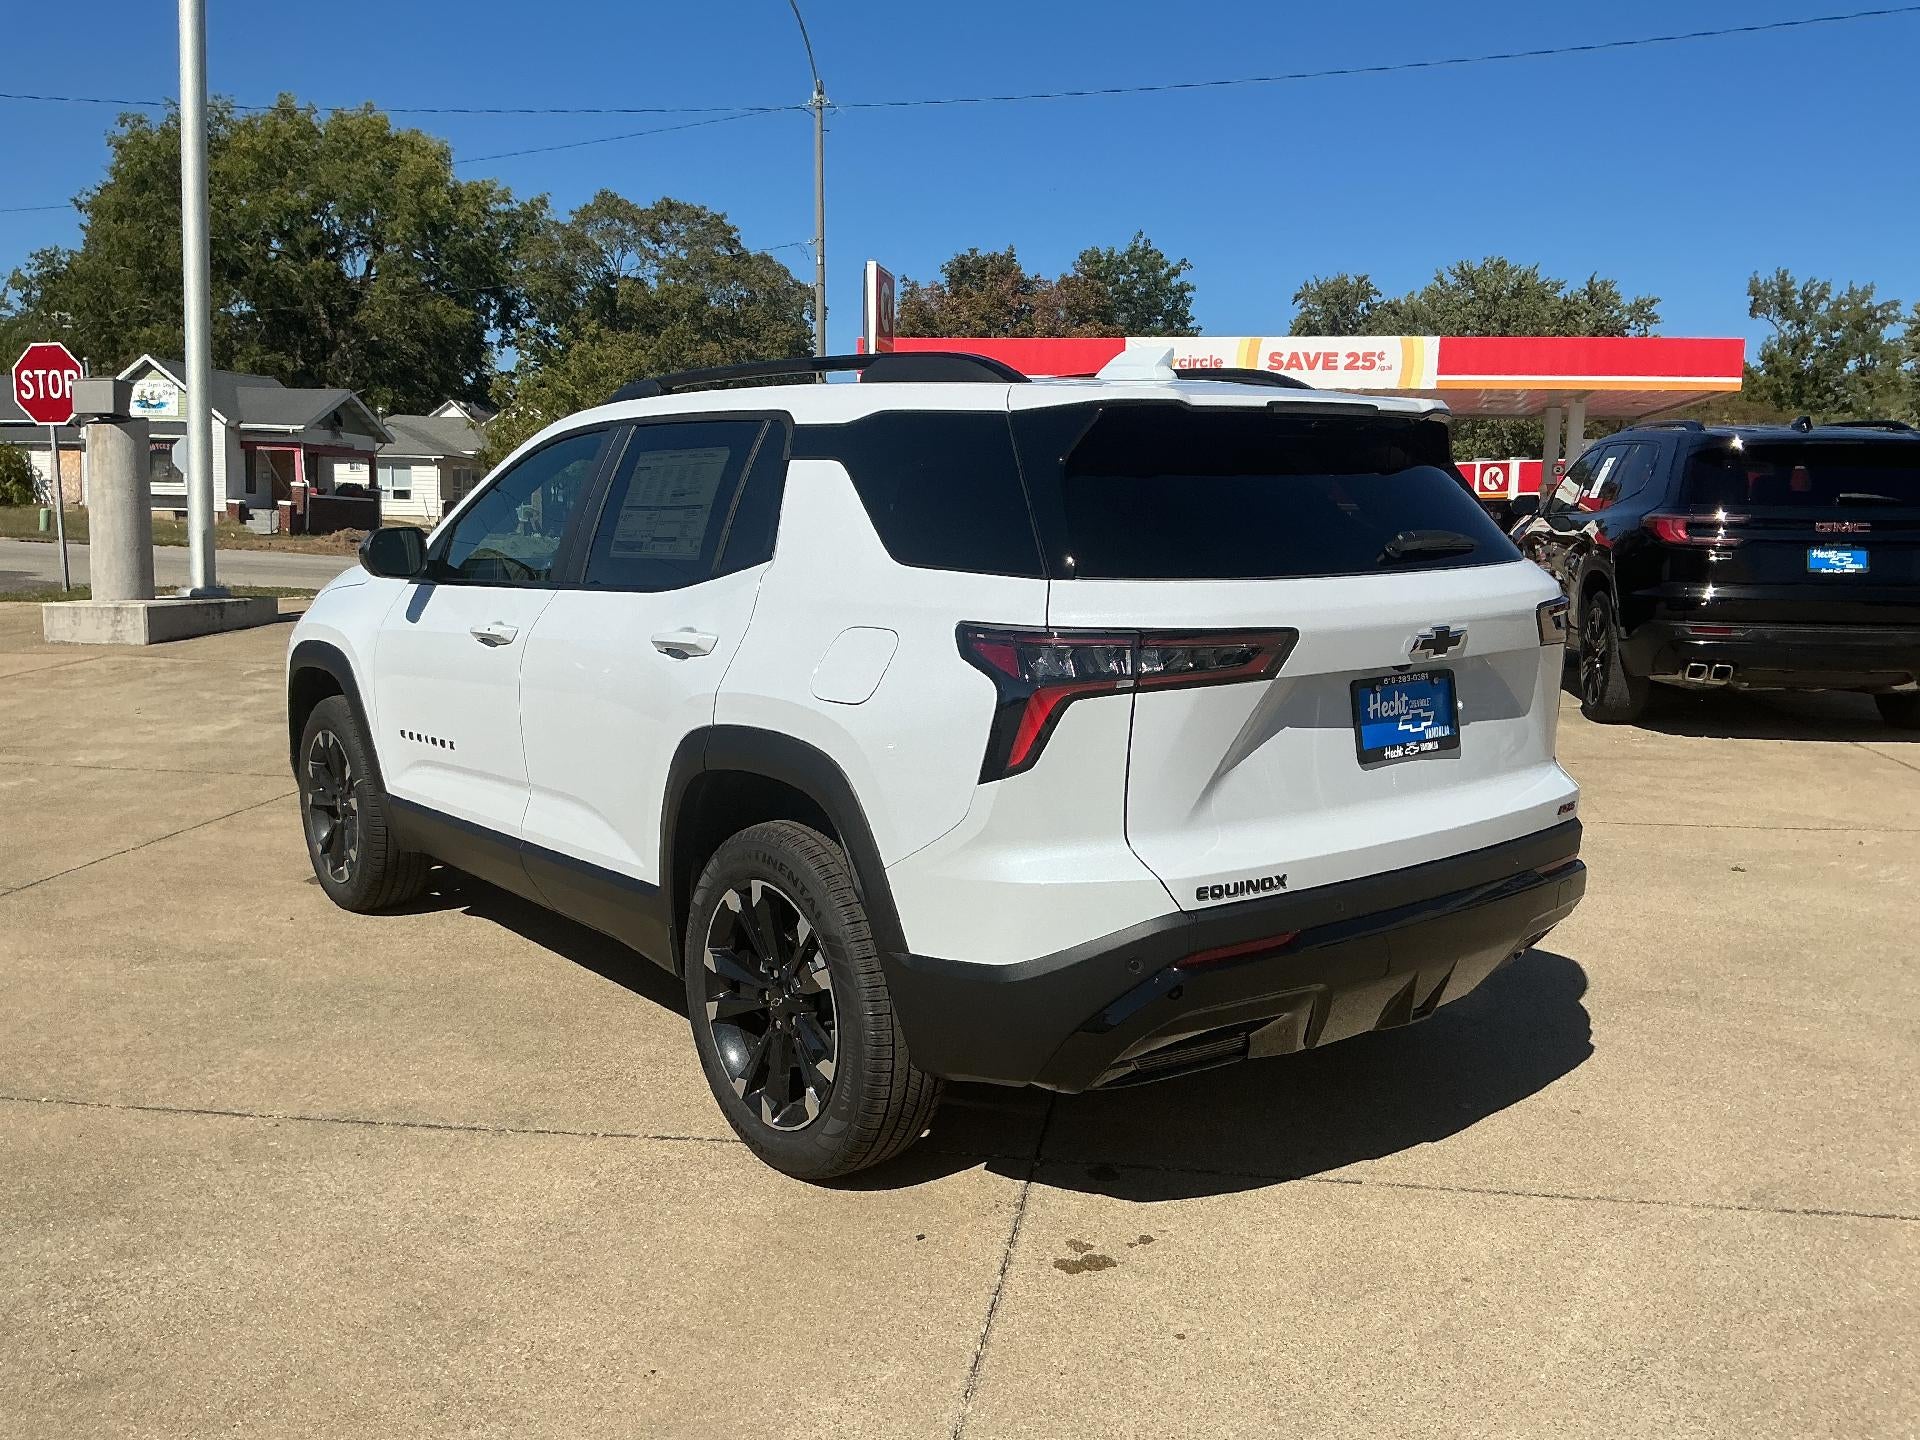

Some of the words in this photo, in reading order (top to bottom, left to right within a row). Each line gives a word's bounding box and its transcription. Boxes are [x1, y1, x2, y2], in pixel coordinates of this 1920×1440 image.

[1267, 351, 1339, 371] SAVE
[20, 369, 78, 400] STOP
[1488, 471, 1501, 486] K
[1368, 690, 1409, 719] Hecht
[400, 729, 456, 751] EQUINOX
[1384, 745, 1404, 760] Hecht
[1195, 873, 1288, 901] EQUINOX
